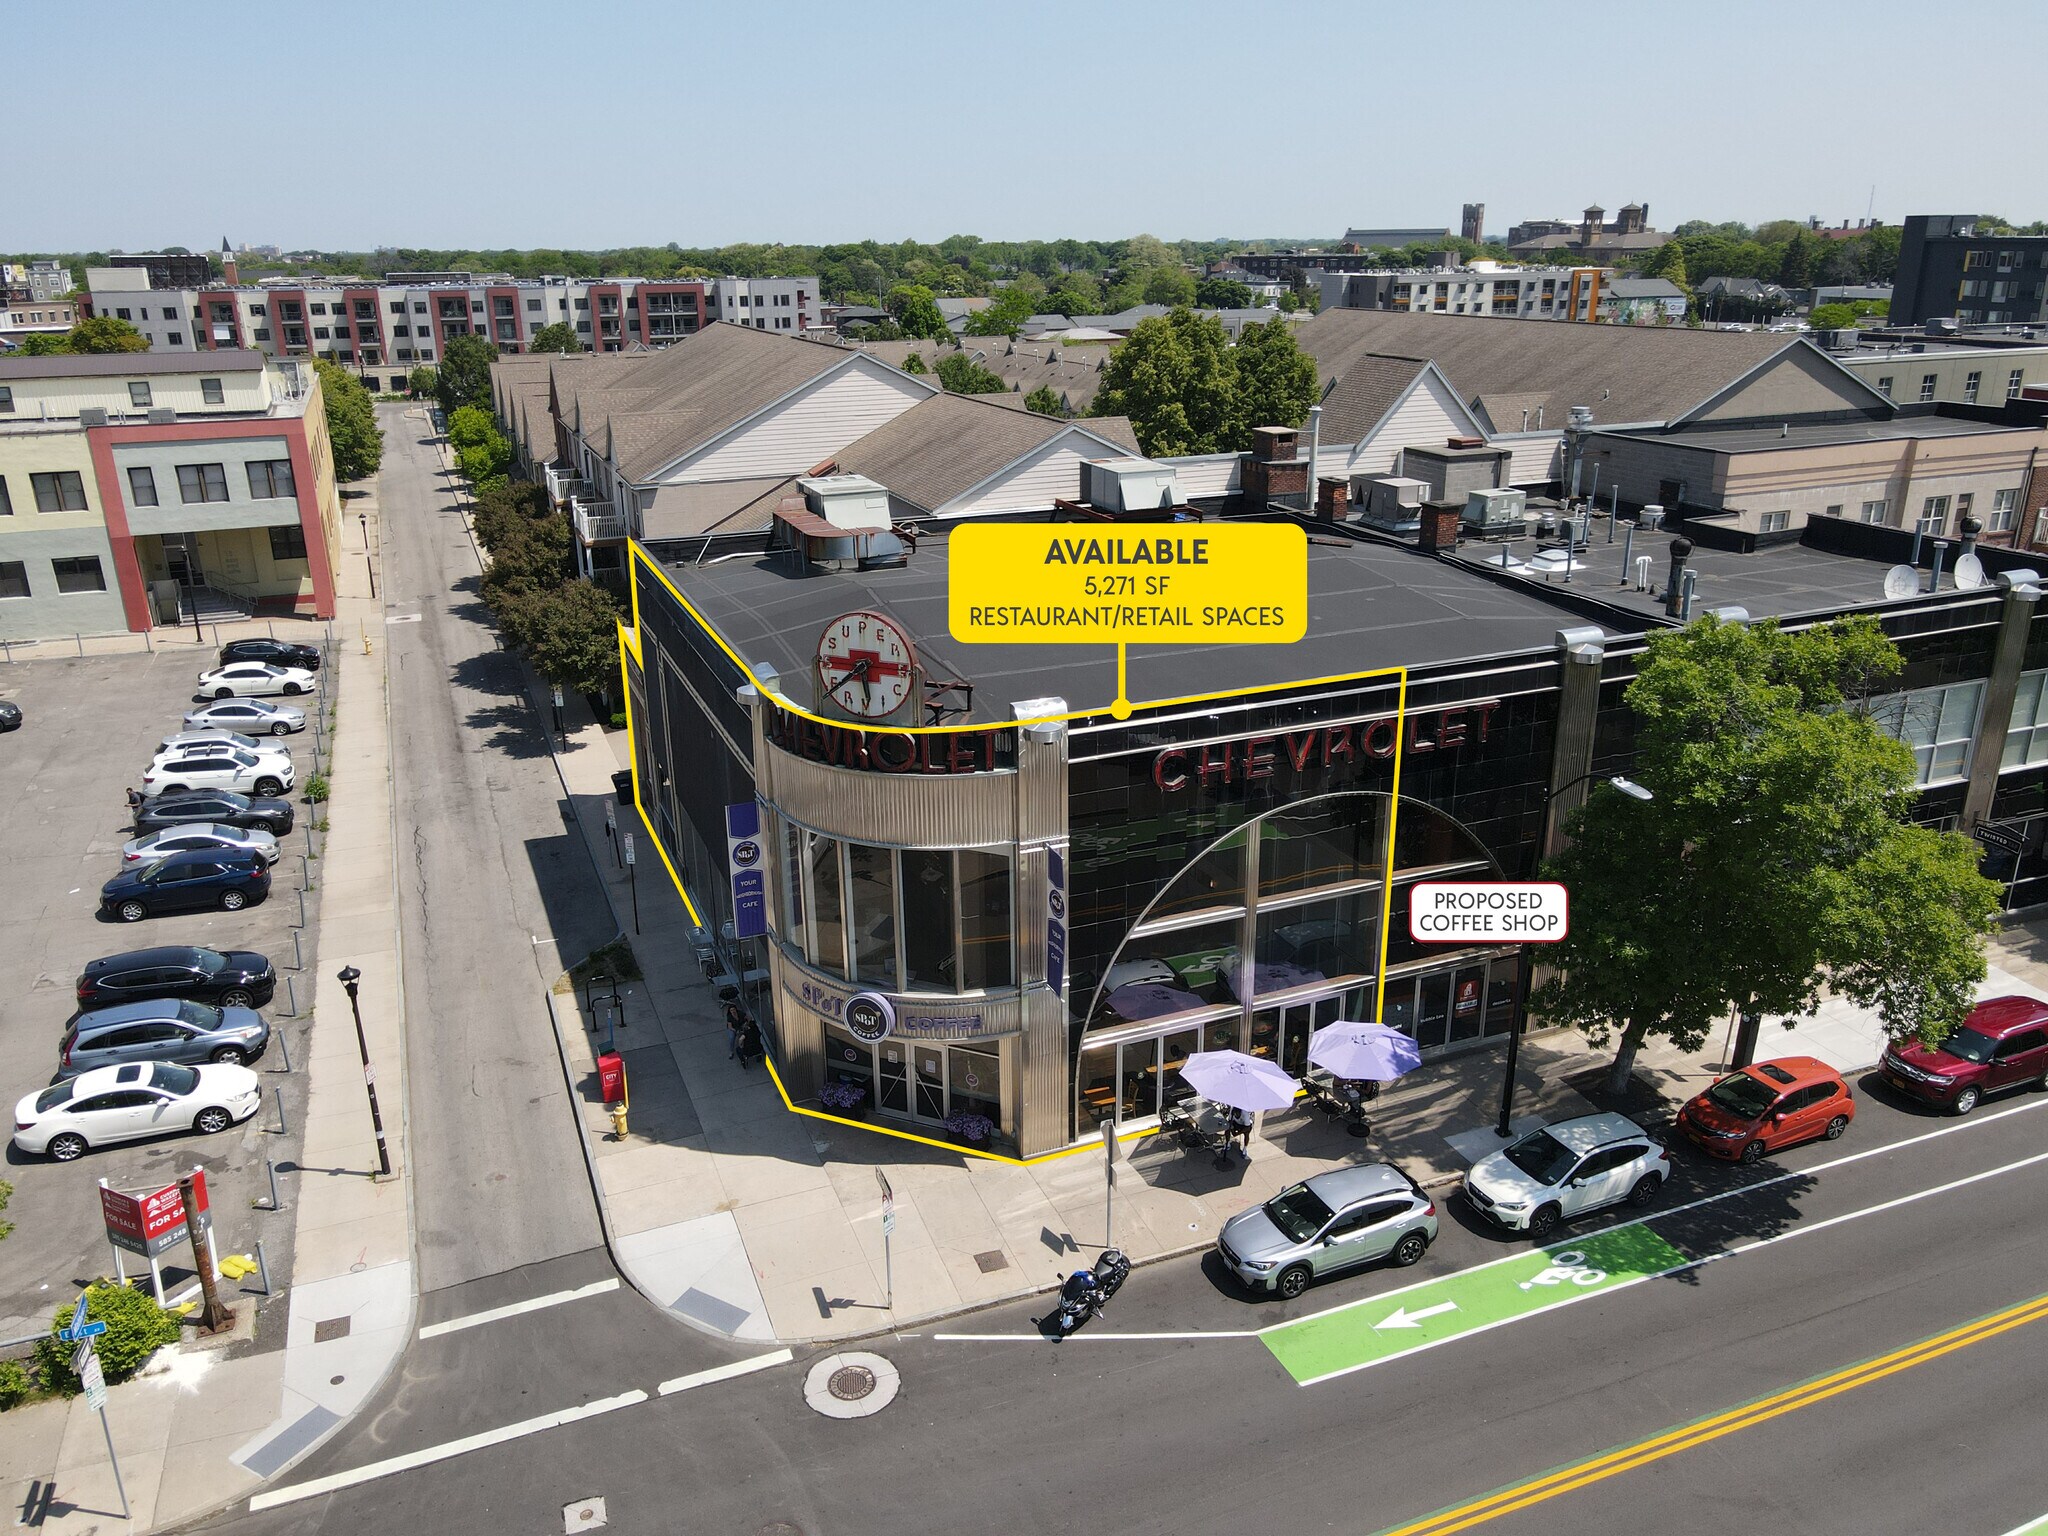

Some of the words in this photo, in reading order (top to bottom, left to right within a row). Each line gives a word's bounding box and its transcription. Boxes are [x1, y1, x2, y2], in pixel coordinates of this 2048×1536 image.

[828, 620, 900, 657] SUPER
[1152, 698, 1501, 793] CHEVROLET
[853, 1025, 880, 1039] COFFEE
[904, 1014, 982, 1031] COFFEE
[105, 1211, 118, 1223] FOR
[119, 1217, 137, 1231] SALE
[149, 1214, 171, 1231] FOR
[172, 1206, 185, 1218] SA
